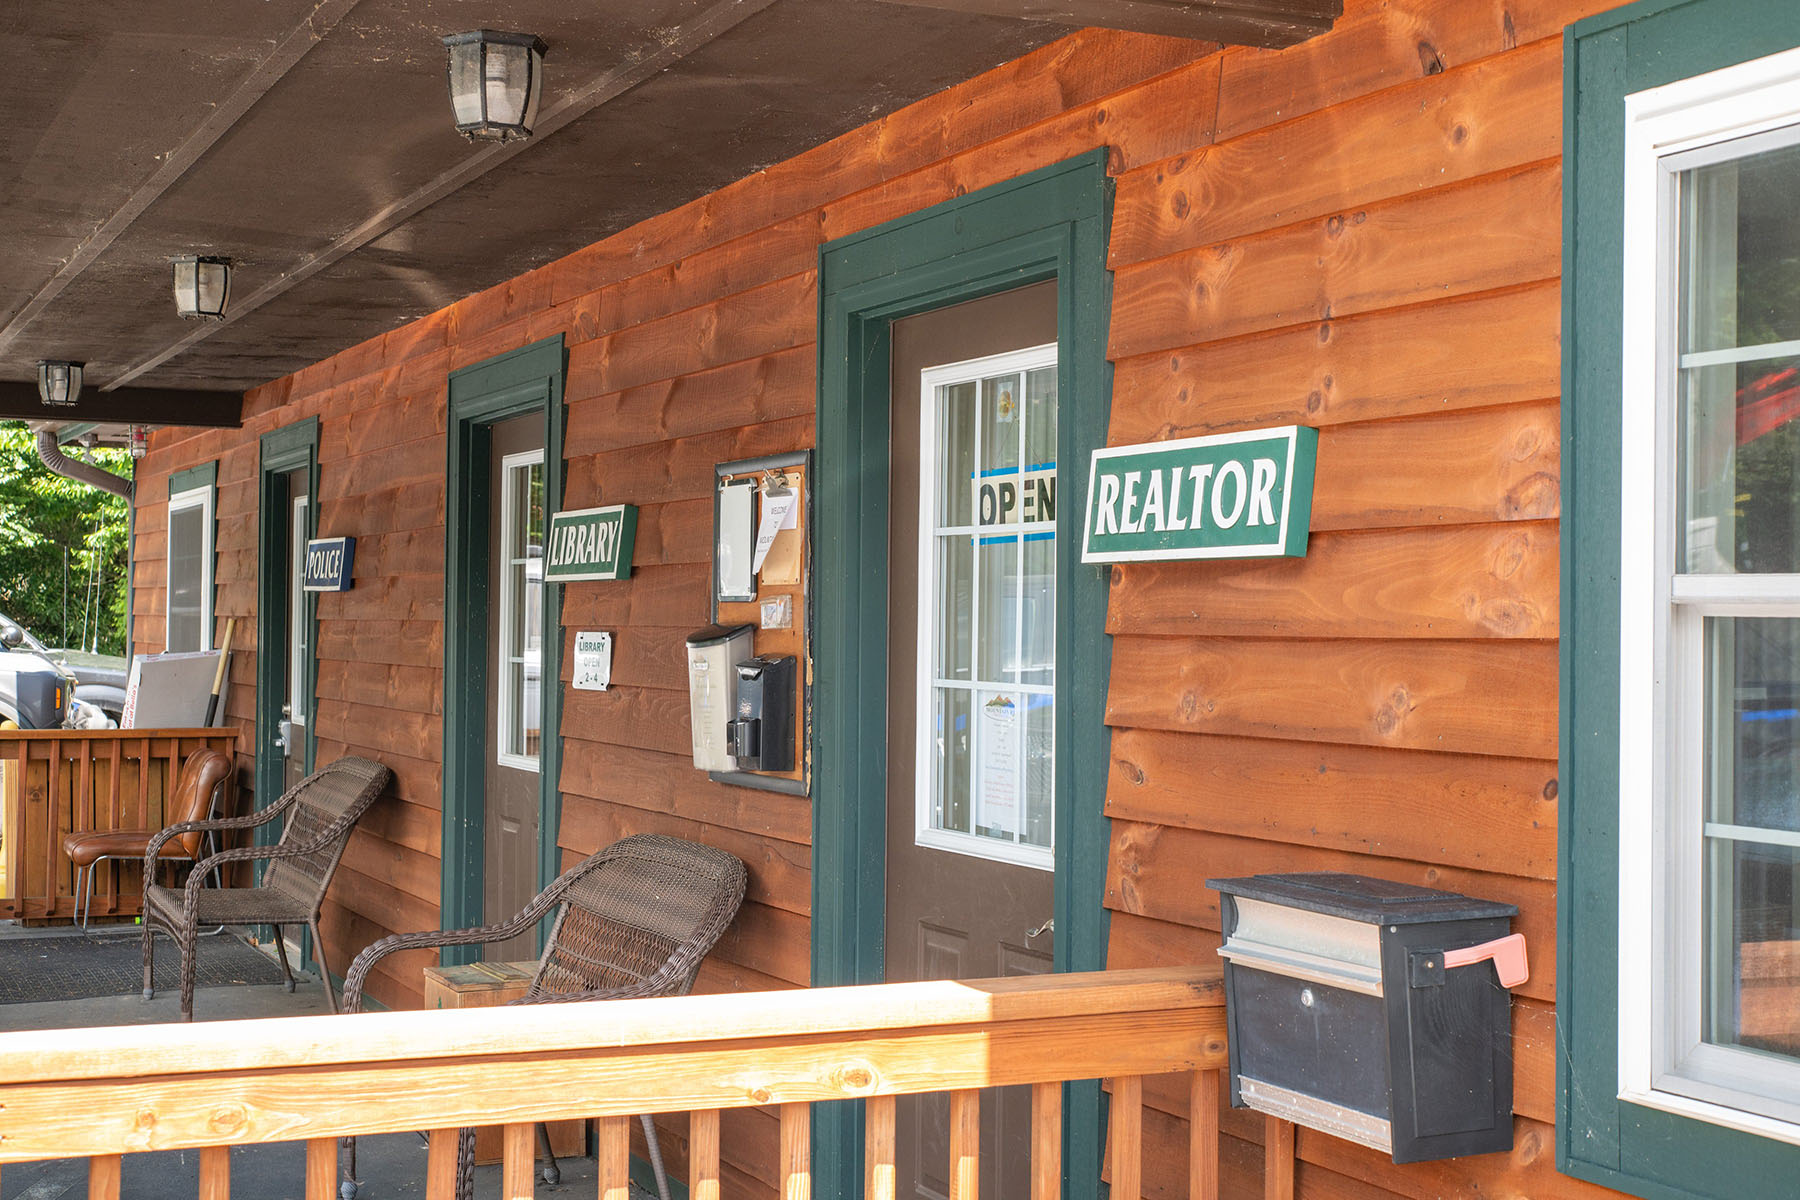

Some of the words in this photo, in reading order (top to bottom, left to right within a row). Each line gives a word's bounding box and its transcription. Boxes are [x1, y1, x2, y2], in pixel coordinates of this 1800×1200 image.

[979, 476, 1057, 526] OPEN
[1094, 458, 1277, 535] REALTOR
[550, 520, 620, 566] LIBRARY
[308, 550, 341, 580] POLICE
[579, 641, 606, 653] LIBRARY
[584, 656, 600, 668] OPEN
